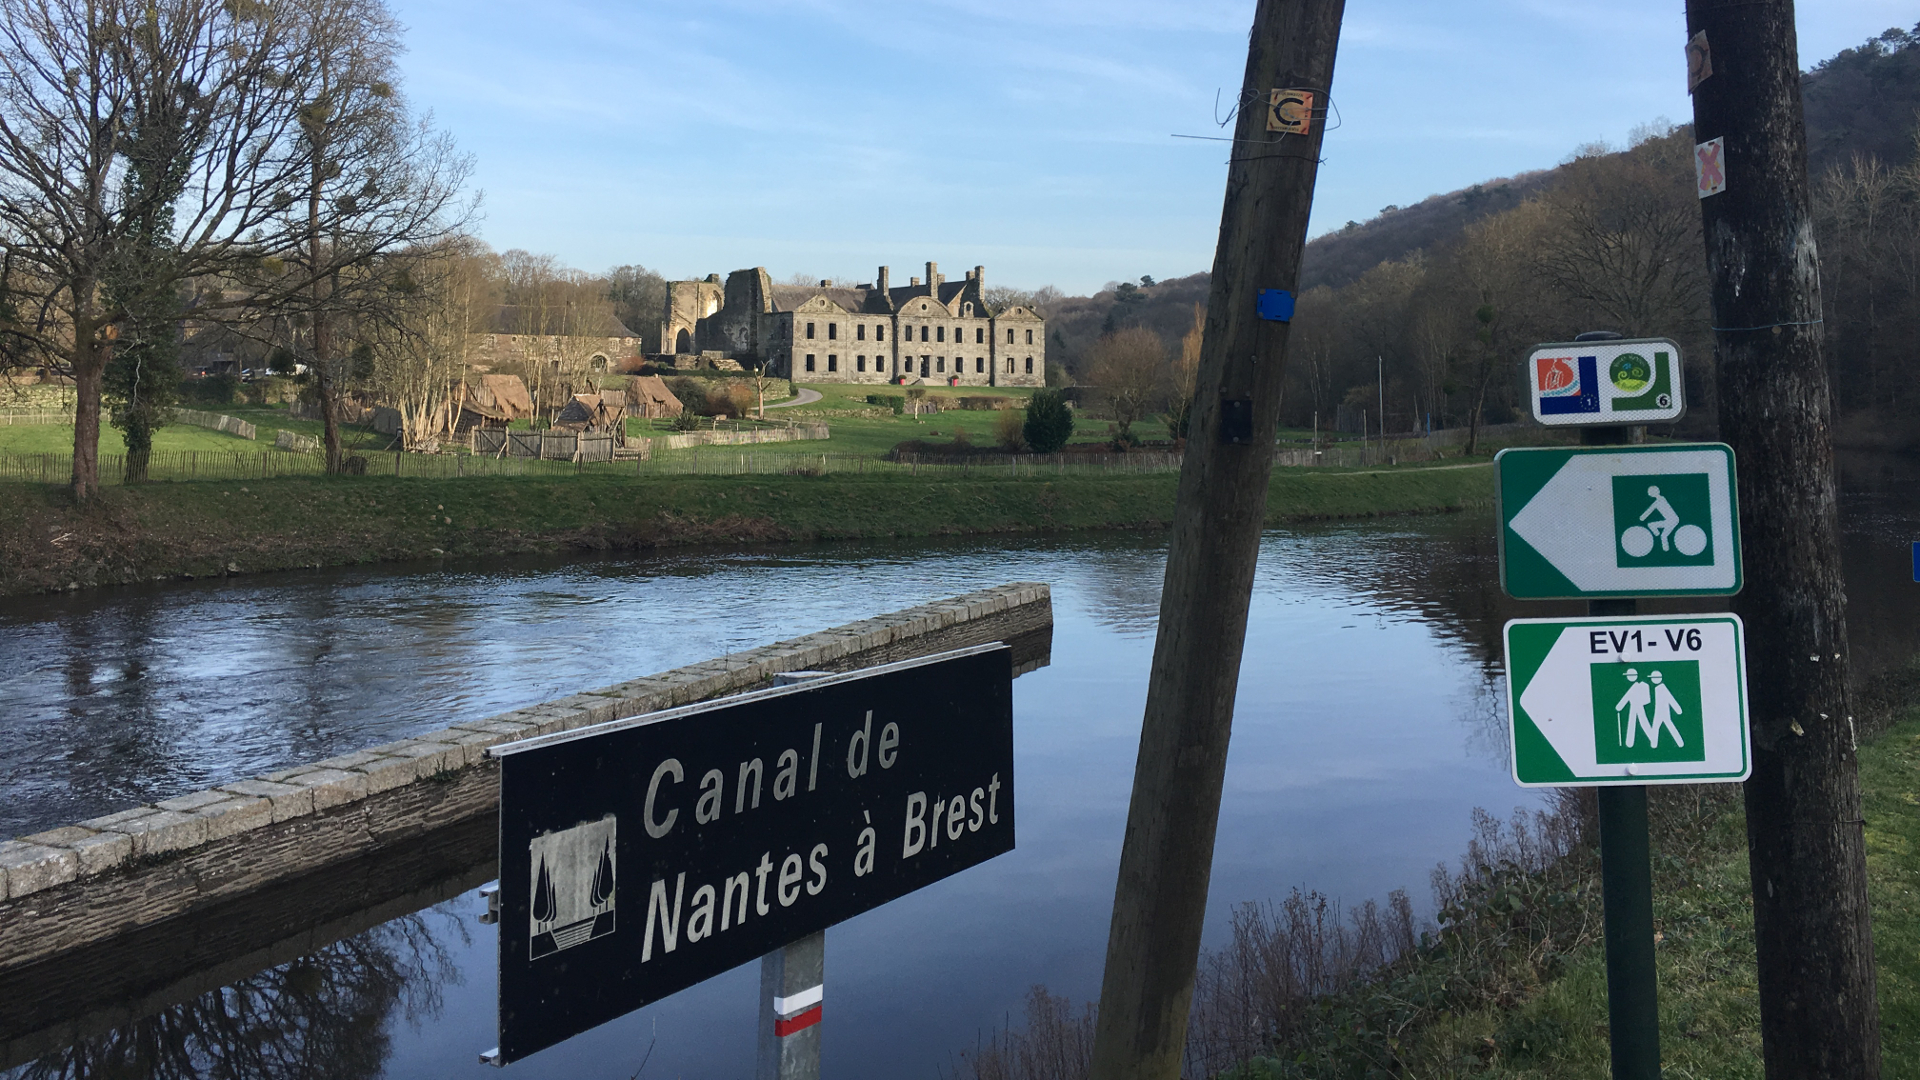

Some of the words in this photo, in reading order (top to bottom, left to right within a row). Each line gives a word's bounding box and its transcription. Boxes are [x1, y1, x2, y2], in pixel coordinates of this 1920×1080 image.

[1586, 396, 1592, 406] 1
[1659, 395, 1668, 406] 6
[643, 722, 823, 839] Canal
[847, 709, 899, 779] de
[641, 842, 829, 964] Nantes
[854, 809, 876, 877] à
[902, 772, 1001, 859] Brest
